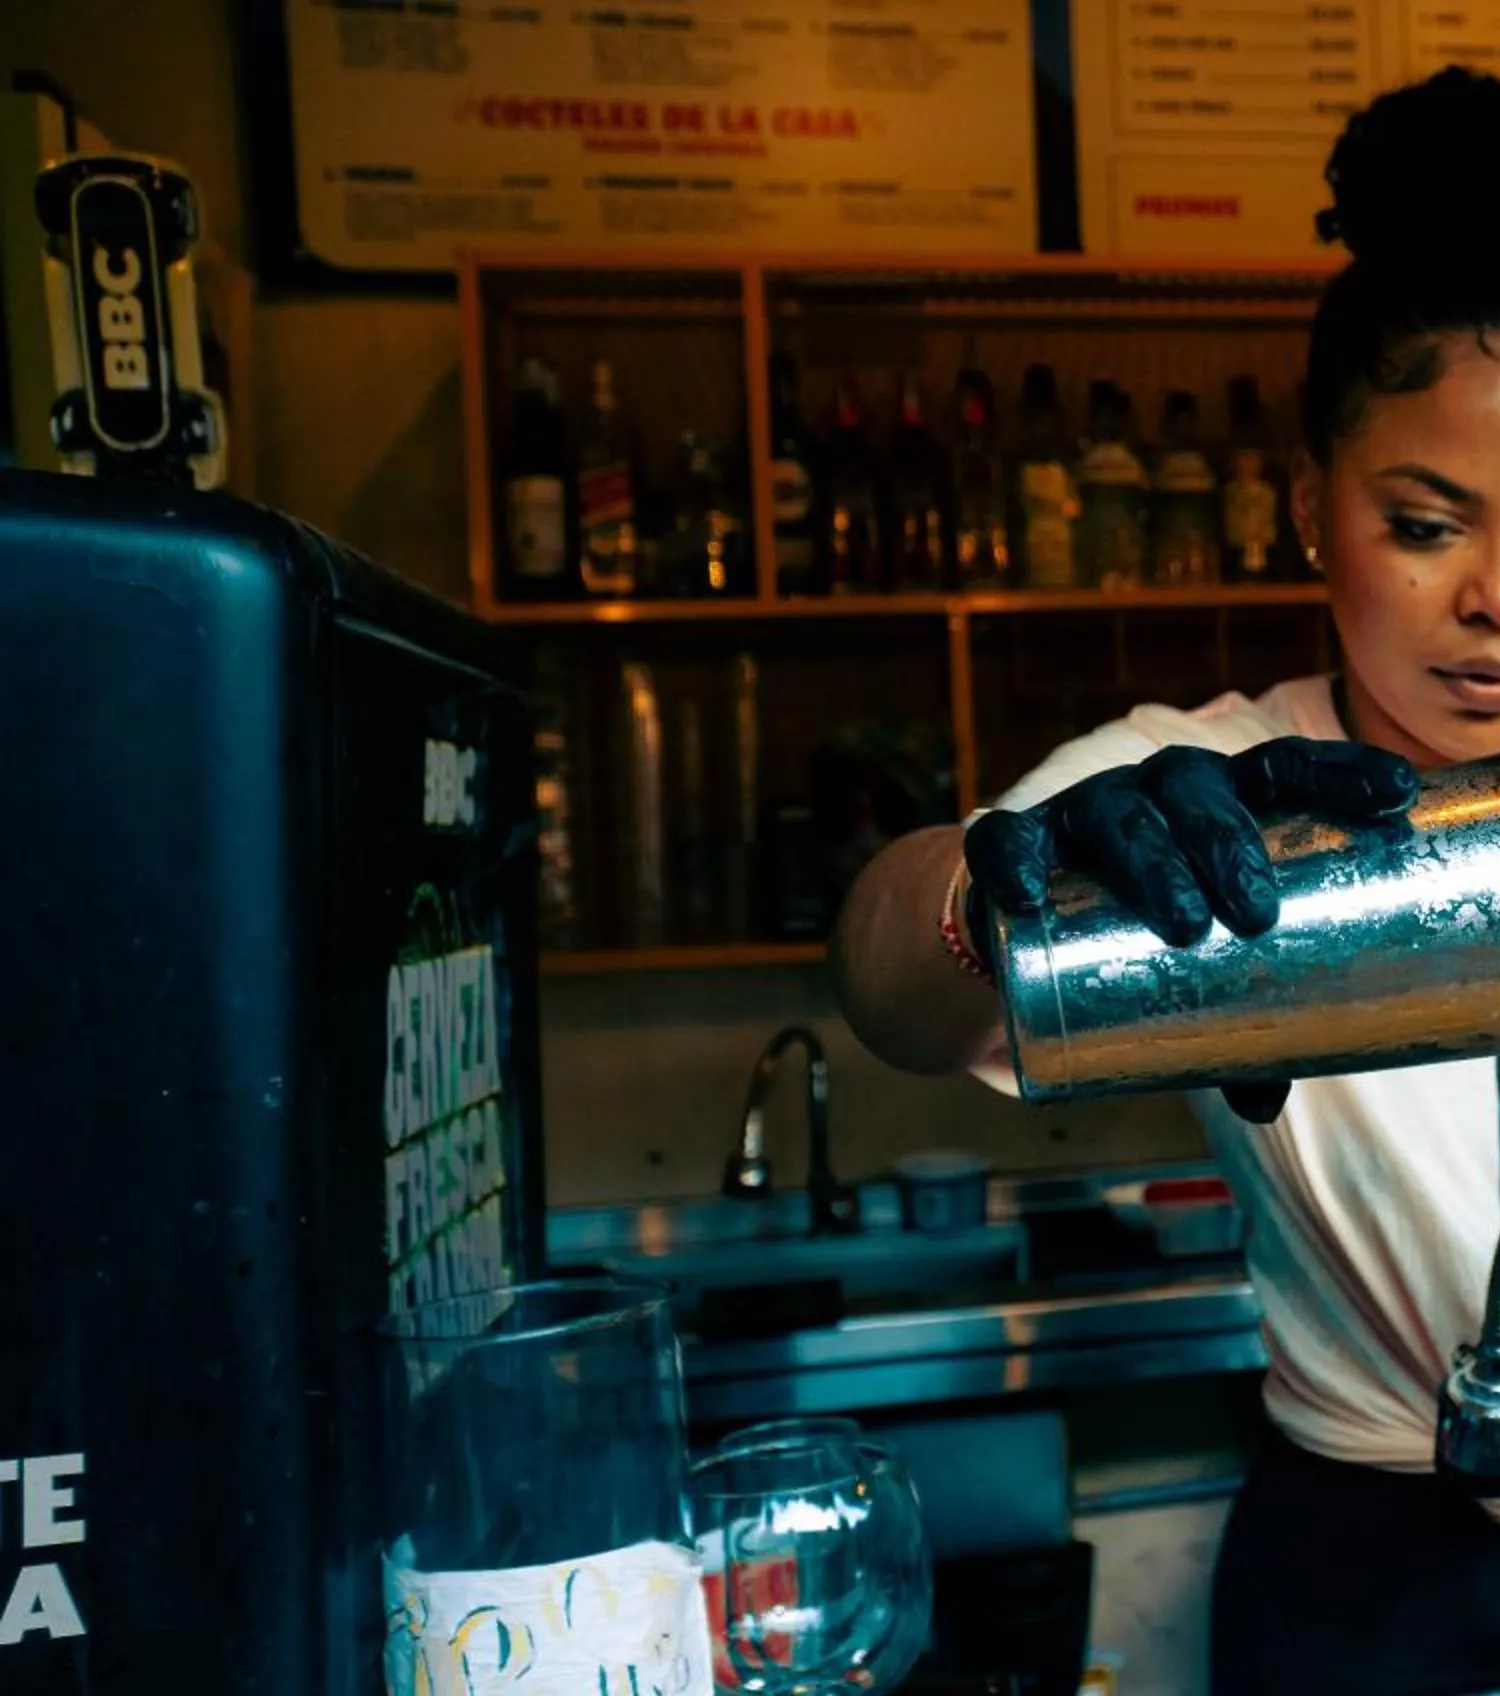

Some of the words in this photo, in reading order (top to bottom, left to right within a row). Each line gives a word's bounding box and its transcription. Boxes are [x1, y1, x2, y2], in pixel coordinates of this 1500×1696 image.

[479, 95, 650, 131] COCTELES
[661, 101, 708, 132] DE
[717, 103, 760, 135] LA
[770, 106, 862, 139] CASA
[92, 243, 149, 390] BBC
[423, 738, 477, 826] BBC
[384, 944, 502, 1149] CERVEZA
[384, 1099, 507, 1266] FRESCA
